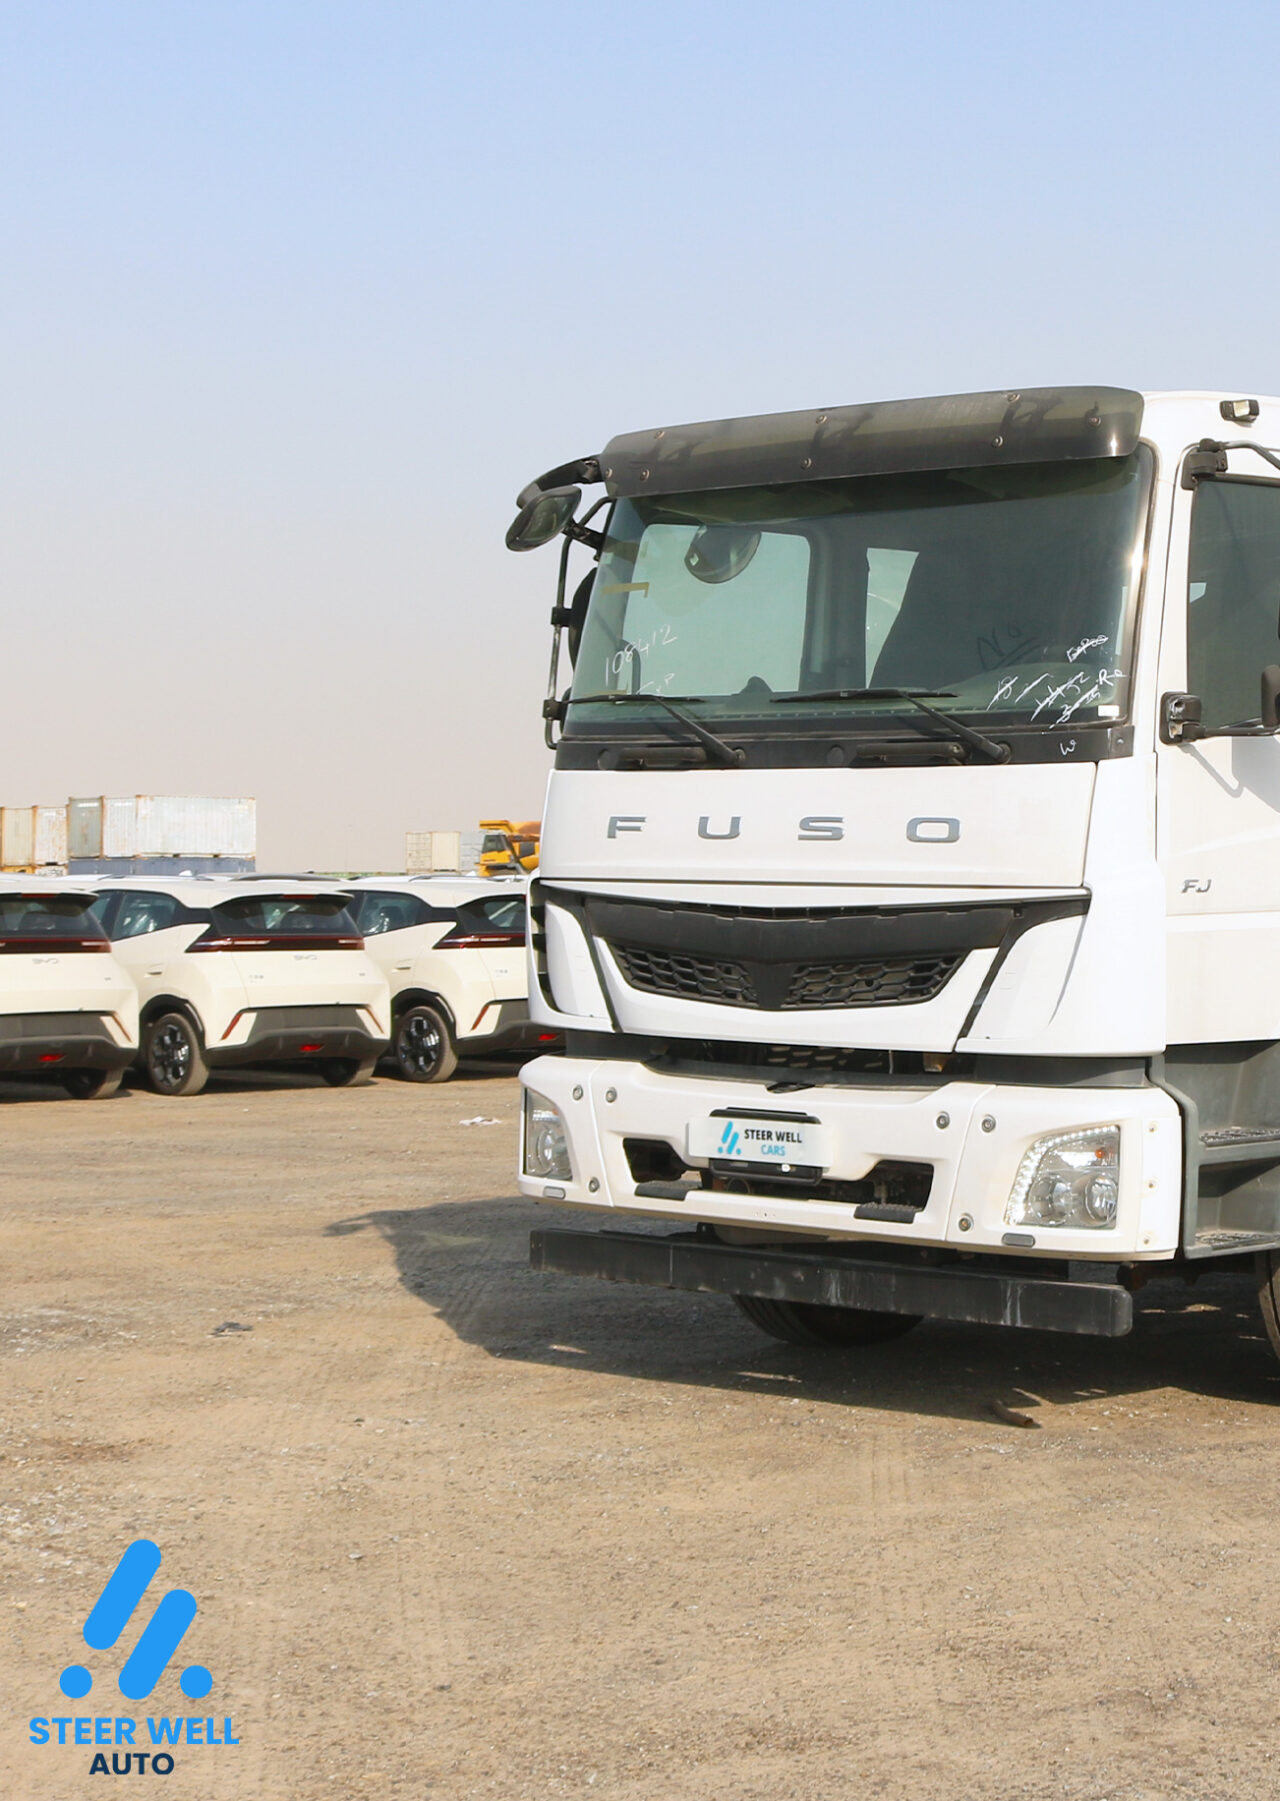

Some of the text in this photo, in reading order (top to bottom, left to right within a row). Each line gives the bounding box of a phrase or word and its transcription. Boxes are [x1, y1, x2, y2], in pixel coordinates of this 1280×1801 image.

[606, 815, 961, 844] FUSO
[1181, 879, 1212, 894] FJ
[744, 1129, 802, 1143] STEER WELL
[761, 1145, 785, 1156] CARS
